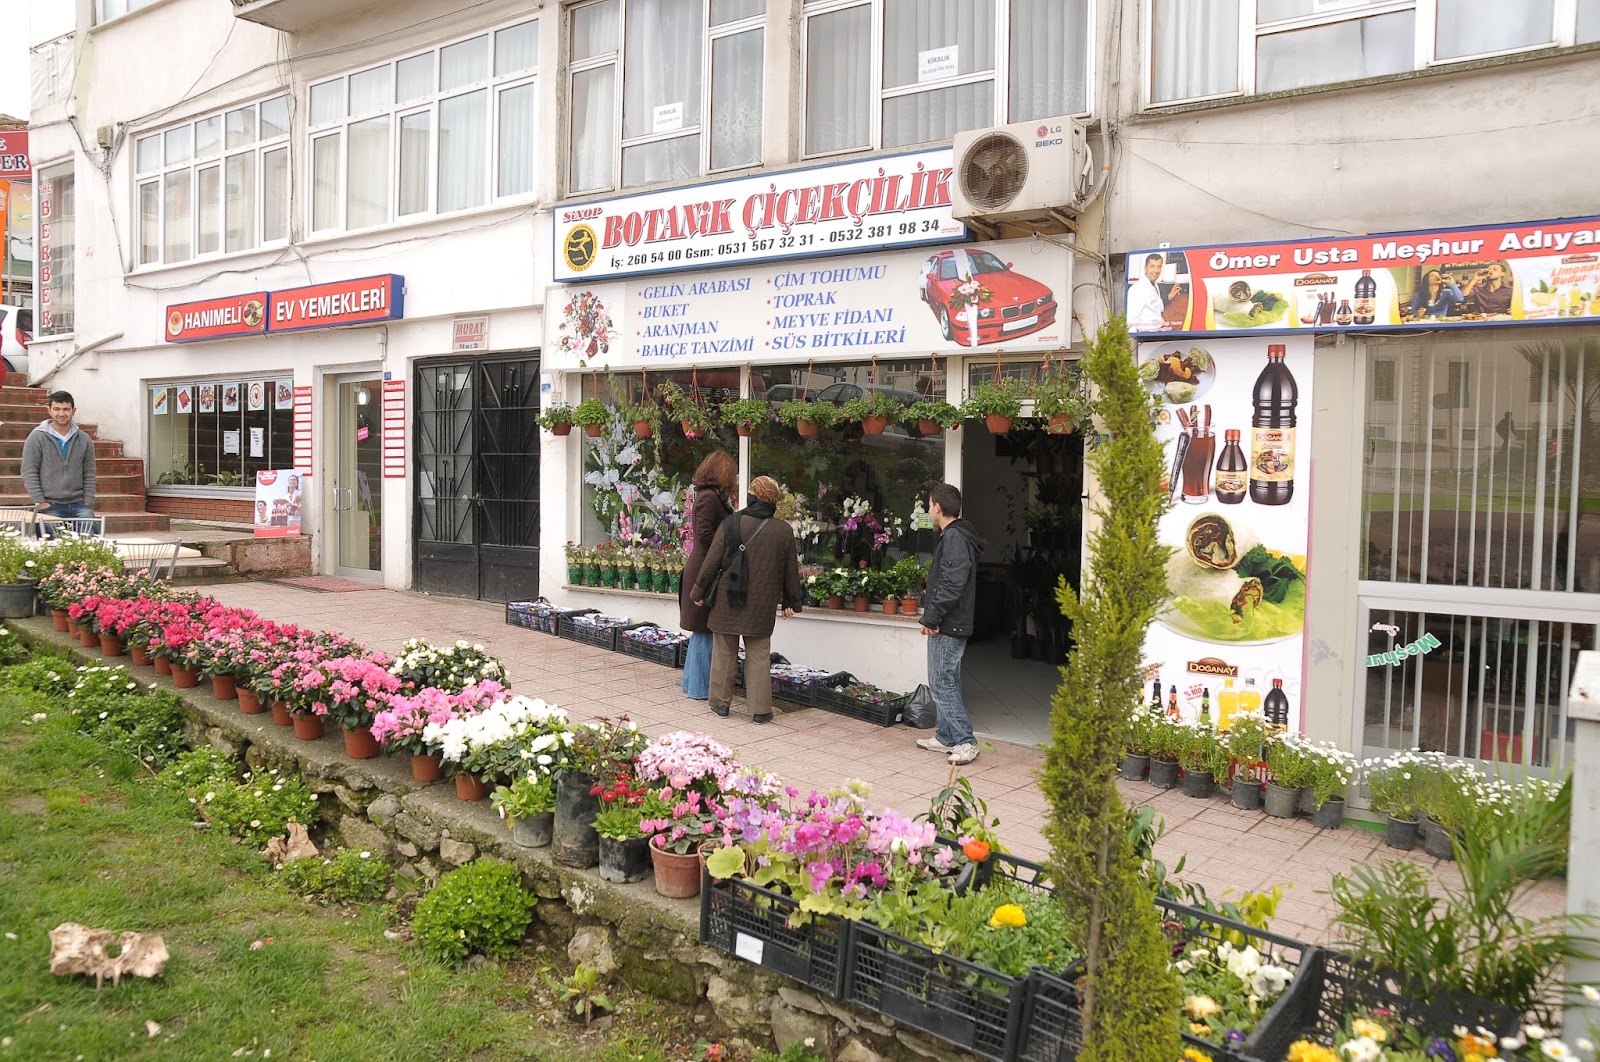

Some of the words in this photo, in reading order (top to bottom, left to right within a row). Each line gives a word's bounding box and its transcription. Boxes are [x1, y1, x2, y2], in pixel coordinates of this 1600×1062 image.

[1050, 126, 1062, 134] LG
[1035, 138, 1063, 148] BEKO
[742, 161, 953, 239] ÇİÇEKÇİLİK
[627, 253, 647, 266] 260
[650, 251, 665, 263] 54
[668, 249, 682, 261] 00
[685, 247, 714, 260] Gsm:
[718, 242, 747, 255] 0531
[752, 238, 775, 251] 567
[779, 235, 795, 249] 32
[799, 233, 815, 246] 31
[829, 228, 863, 243] 0532
[868, 224, 892, 239] 381
[899, 222, 916, 235] 98
[921, 219, 940, 232] 34
[1209, 251, 1281, 271] Ömer
[1294, 246, 1358, 267] Usta
[1372, 238, 1485, 263] Meşhur
[774, 269, 805, 290] ÇİM
[809, 264, 887, 284] TOHUMU
[1552, 274, 1588, 286] Budur
[643, 282, 685, 300] GELİN
[688, 278, 752, 296] ARABASI
[773, 291, 837, 309] TOPRAK
[276, 300, 296, 322] EV
[298, 280, 386, 319] YEMEKLERİ
[643, 303, 690, 319] BUKET
[184, 301, 242, 330] HANIMELİ
[773, 312, 830, 330] MEYVE
[834, 307, 894, 325] FİDANI
[455, 321, 484, 336] MURAT
[642, 321, 720, 338] ARANJMAN
[772, 332, 806, 351] SÜS
[811, 326, 906, 348] BİTKİLERİ
[641, 341, 687, 359] BAHÇE
[691, 336, 755, 355] TANZİMİ
